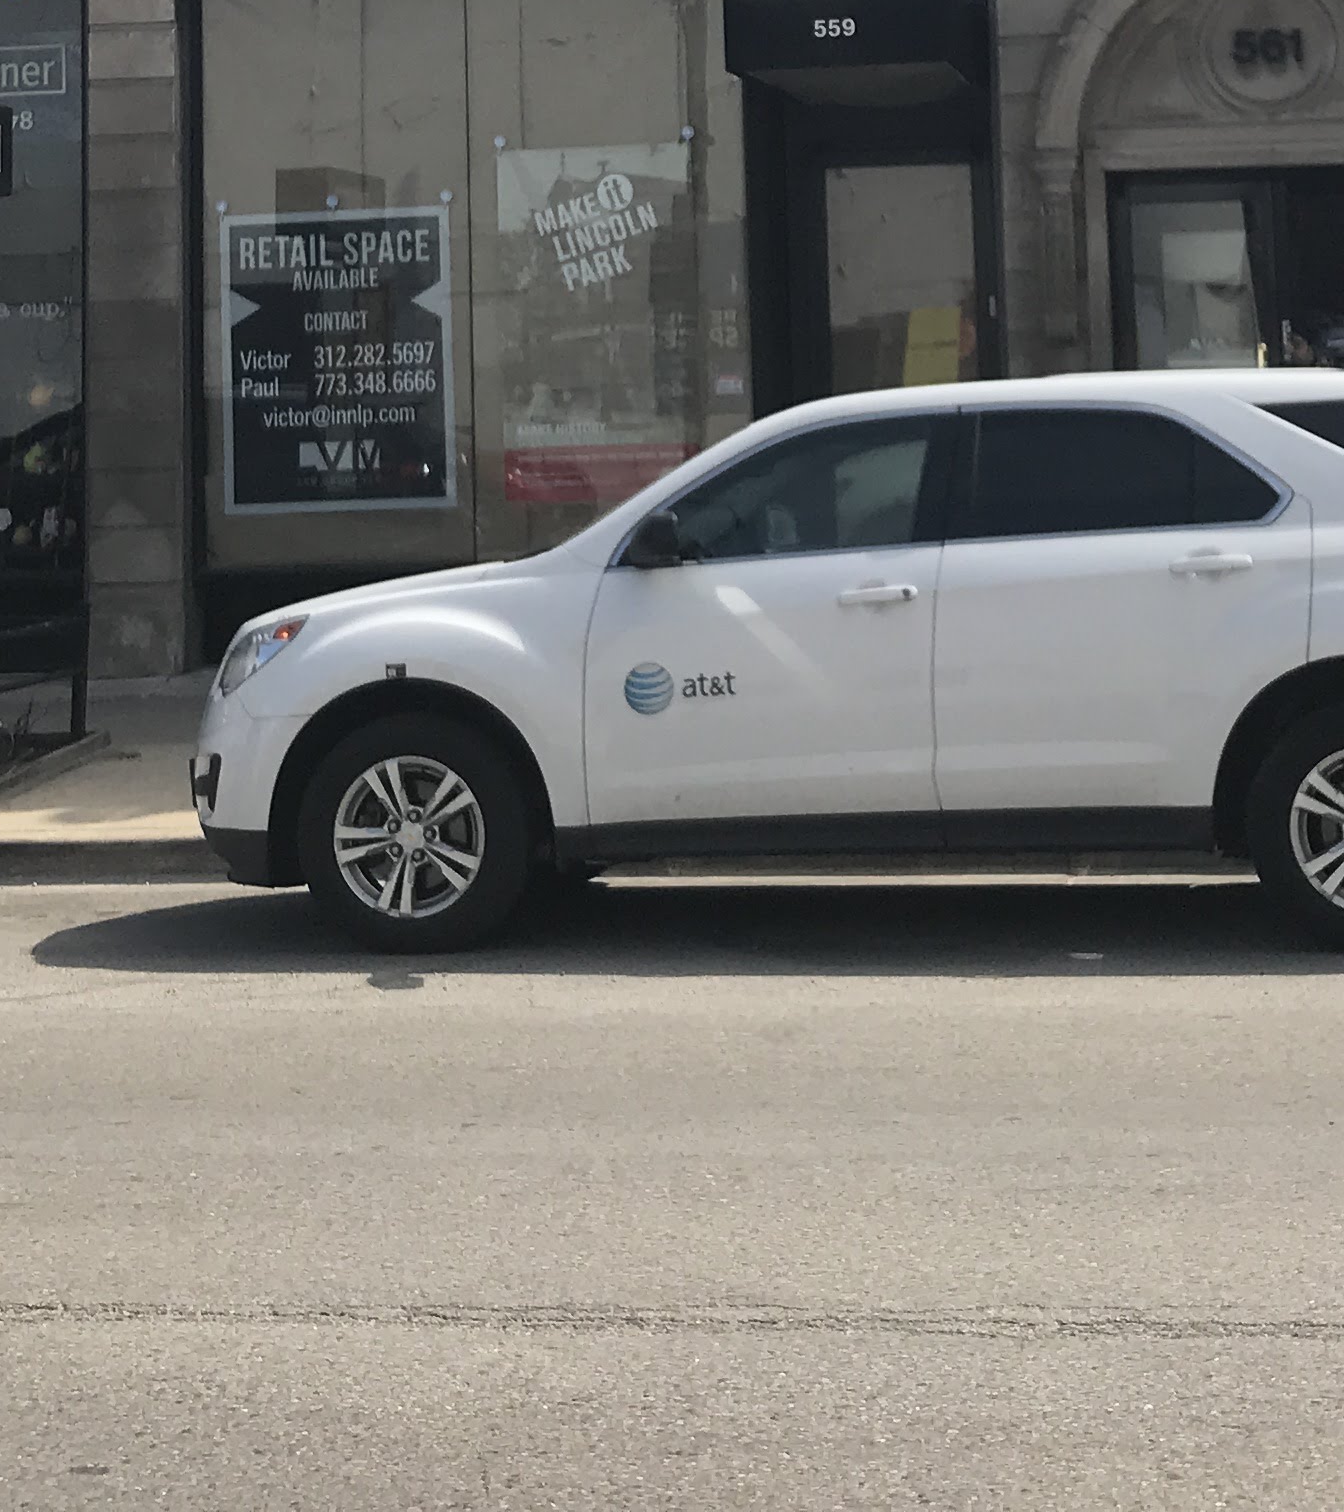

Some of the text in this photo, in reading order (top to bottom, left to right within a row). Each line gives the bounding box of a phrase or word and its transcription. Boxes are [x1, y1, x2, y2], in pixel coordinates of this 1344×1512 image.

[814, 18, 856, 38] 559
[534, 177, 629, 237] MAKE it
[552, 200, 658, 262] LINCOLN
[239, 229, 430, 270] RETAIL SPACE
[292, 267, 379, 291] AVAILABLE
[561, 244, 633, 292] PARK
[304, 310, 369, 332] CONTACT
[240, 341, 436, 370] Victor 312.282.5697
[241, 369, 437, 398] Paul 773.348.6666
[262, 403, 417, 429] victor@innlp.com
[682, 672, 737, 698] at&t
